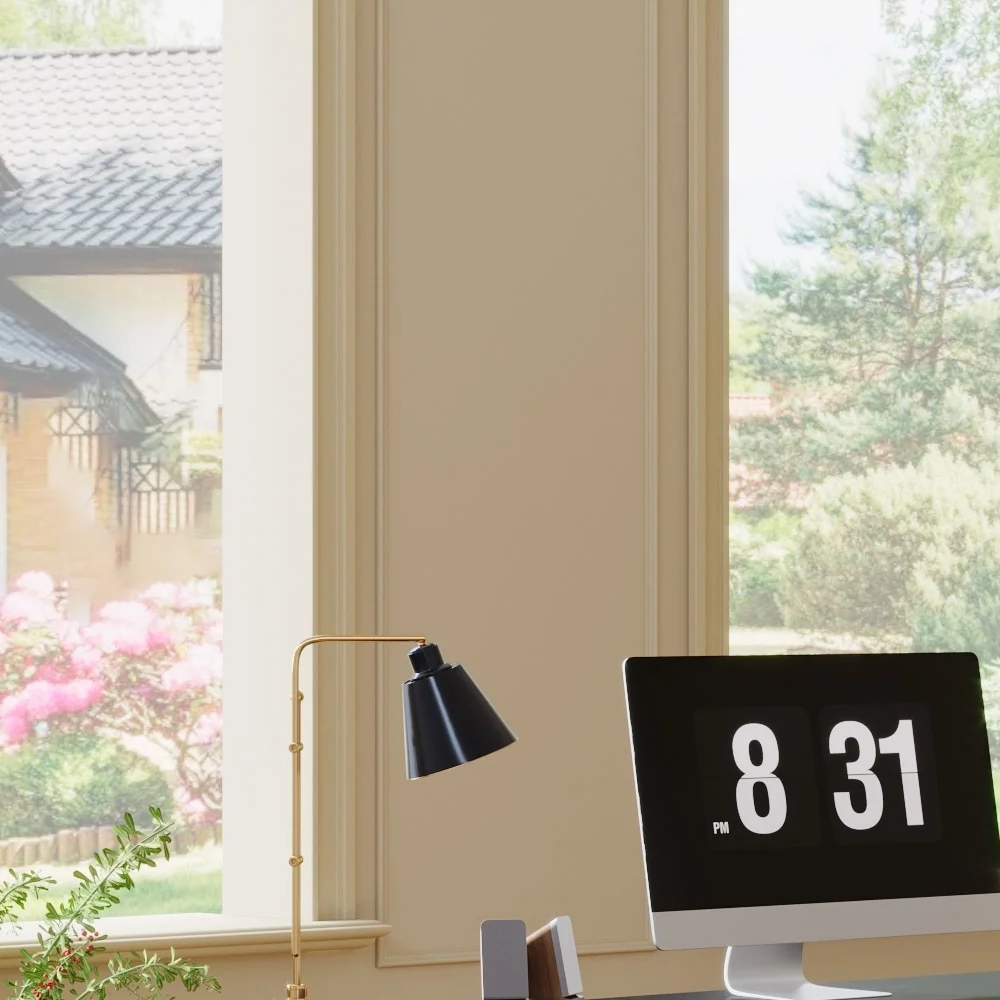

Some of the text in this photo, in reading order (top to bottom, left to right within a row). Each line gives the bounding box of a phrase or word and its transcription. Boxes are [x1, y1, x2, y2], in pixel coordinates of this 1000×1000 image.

[732, 719, 924, 834] 8 31
[713, 821, 730, 834] PM
